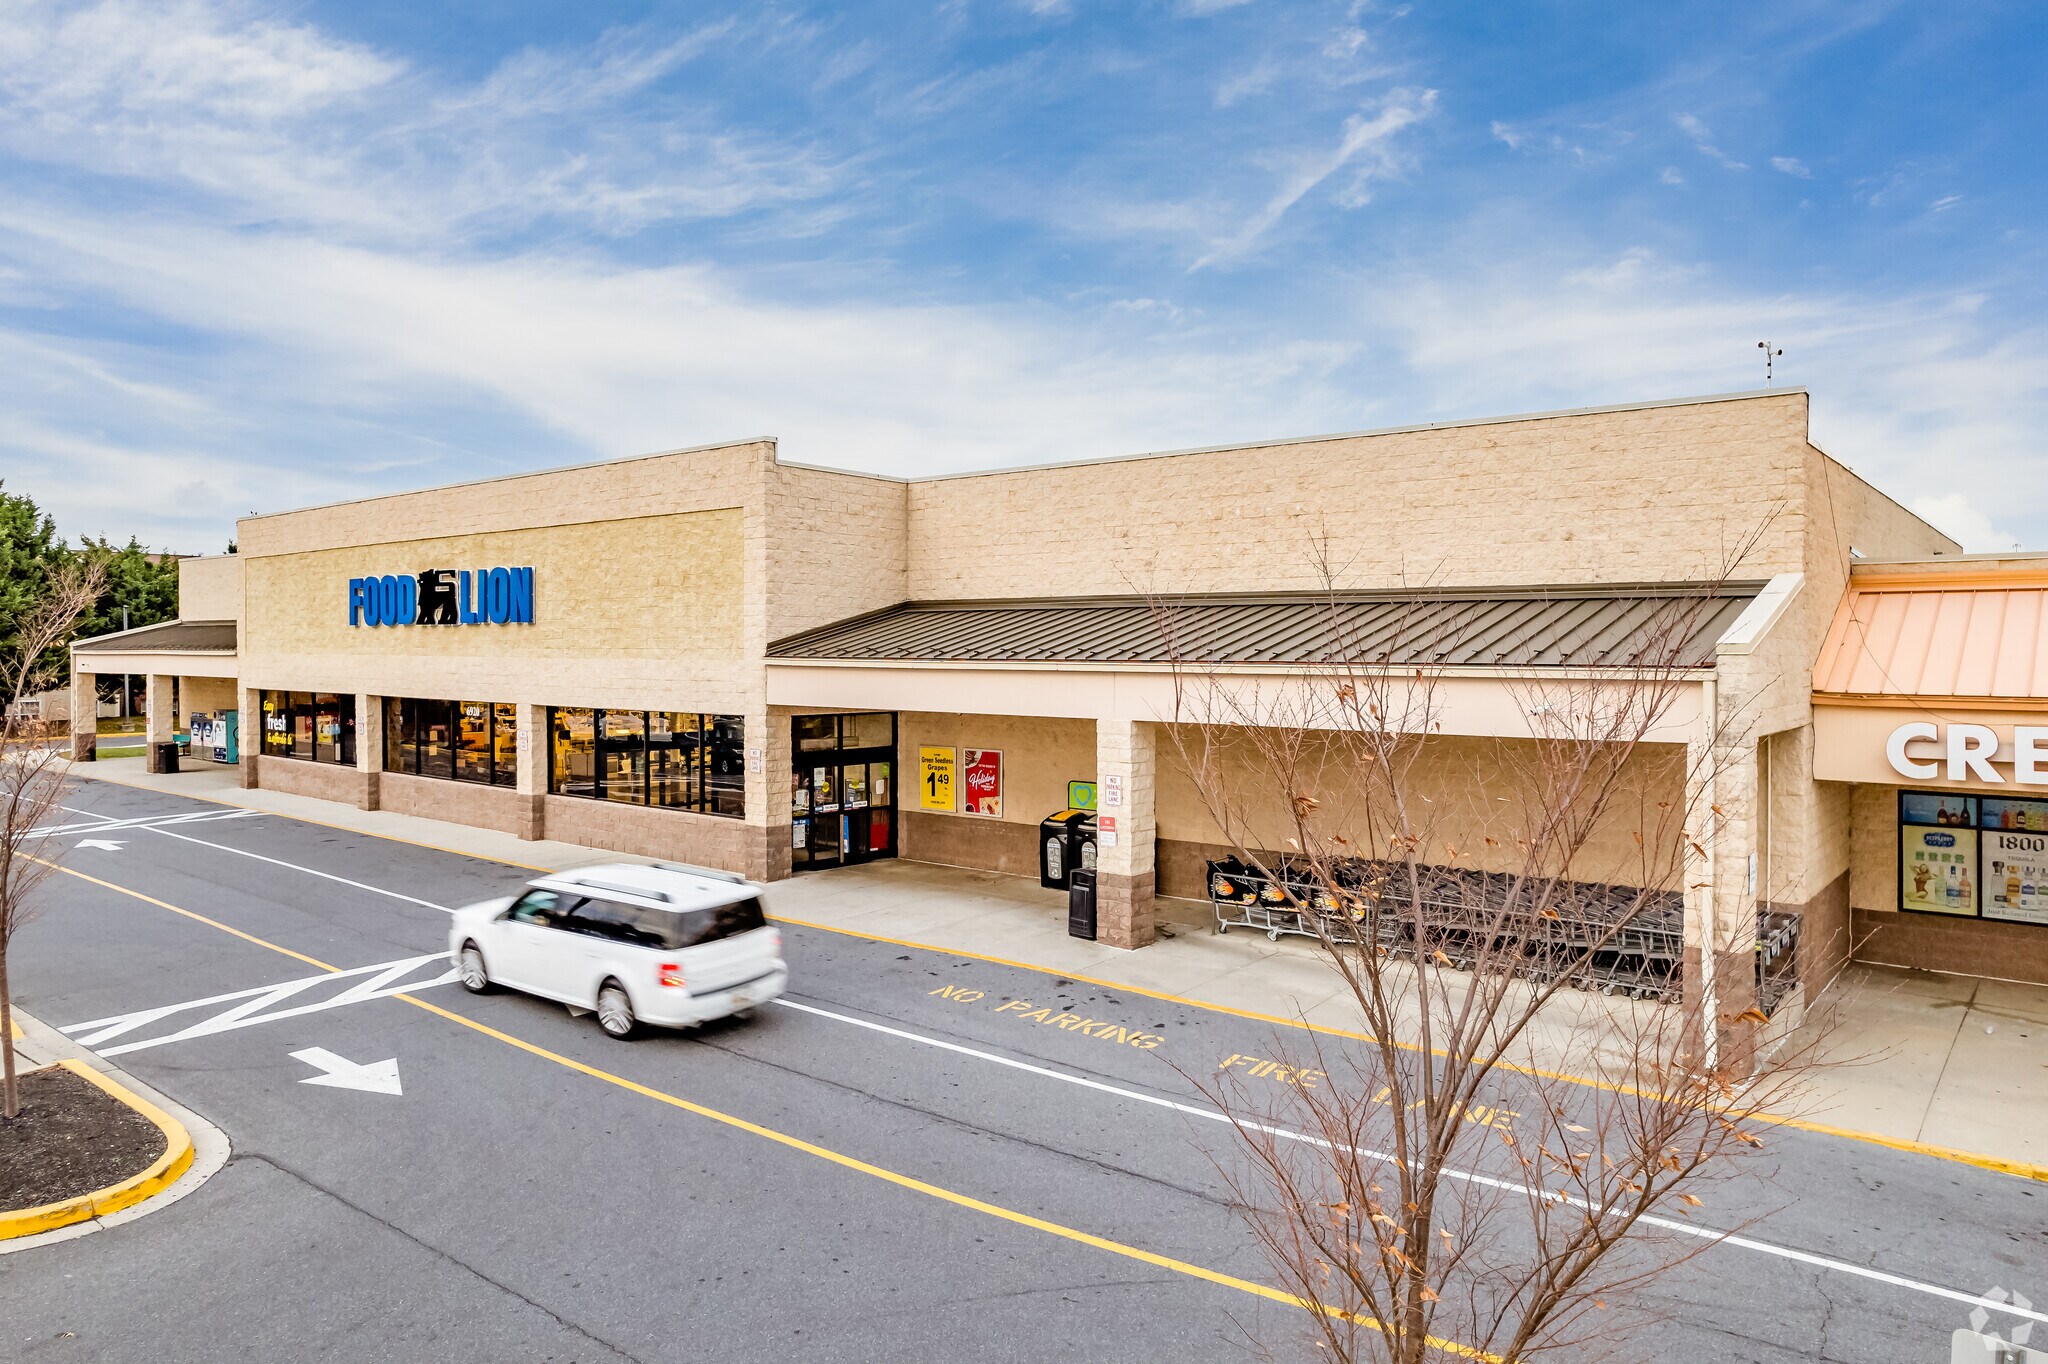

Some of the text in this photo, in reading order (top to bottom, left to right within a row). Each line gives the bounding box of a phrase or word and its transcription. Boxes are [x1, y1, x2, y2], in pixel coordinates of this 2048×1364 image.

[348, 566, 536, 627] FOOD LION
[267, 713, 287, 732] fresh
[927, 764, 948, 772] Grapes
[934, 757, 954, 765] Seedless
[968, 770, 996, 790] Holiday
[1999, 835, 2045, 852] 1800
[928, 984, 985, 1003] NO
[994, 1000, 1165, 1049] PARKING
[1218, 1053, 1330, 1089] FIRE
